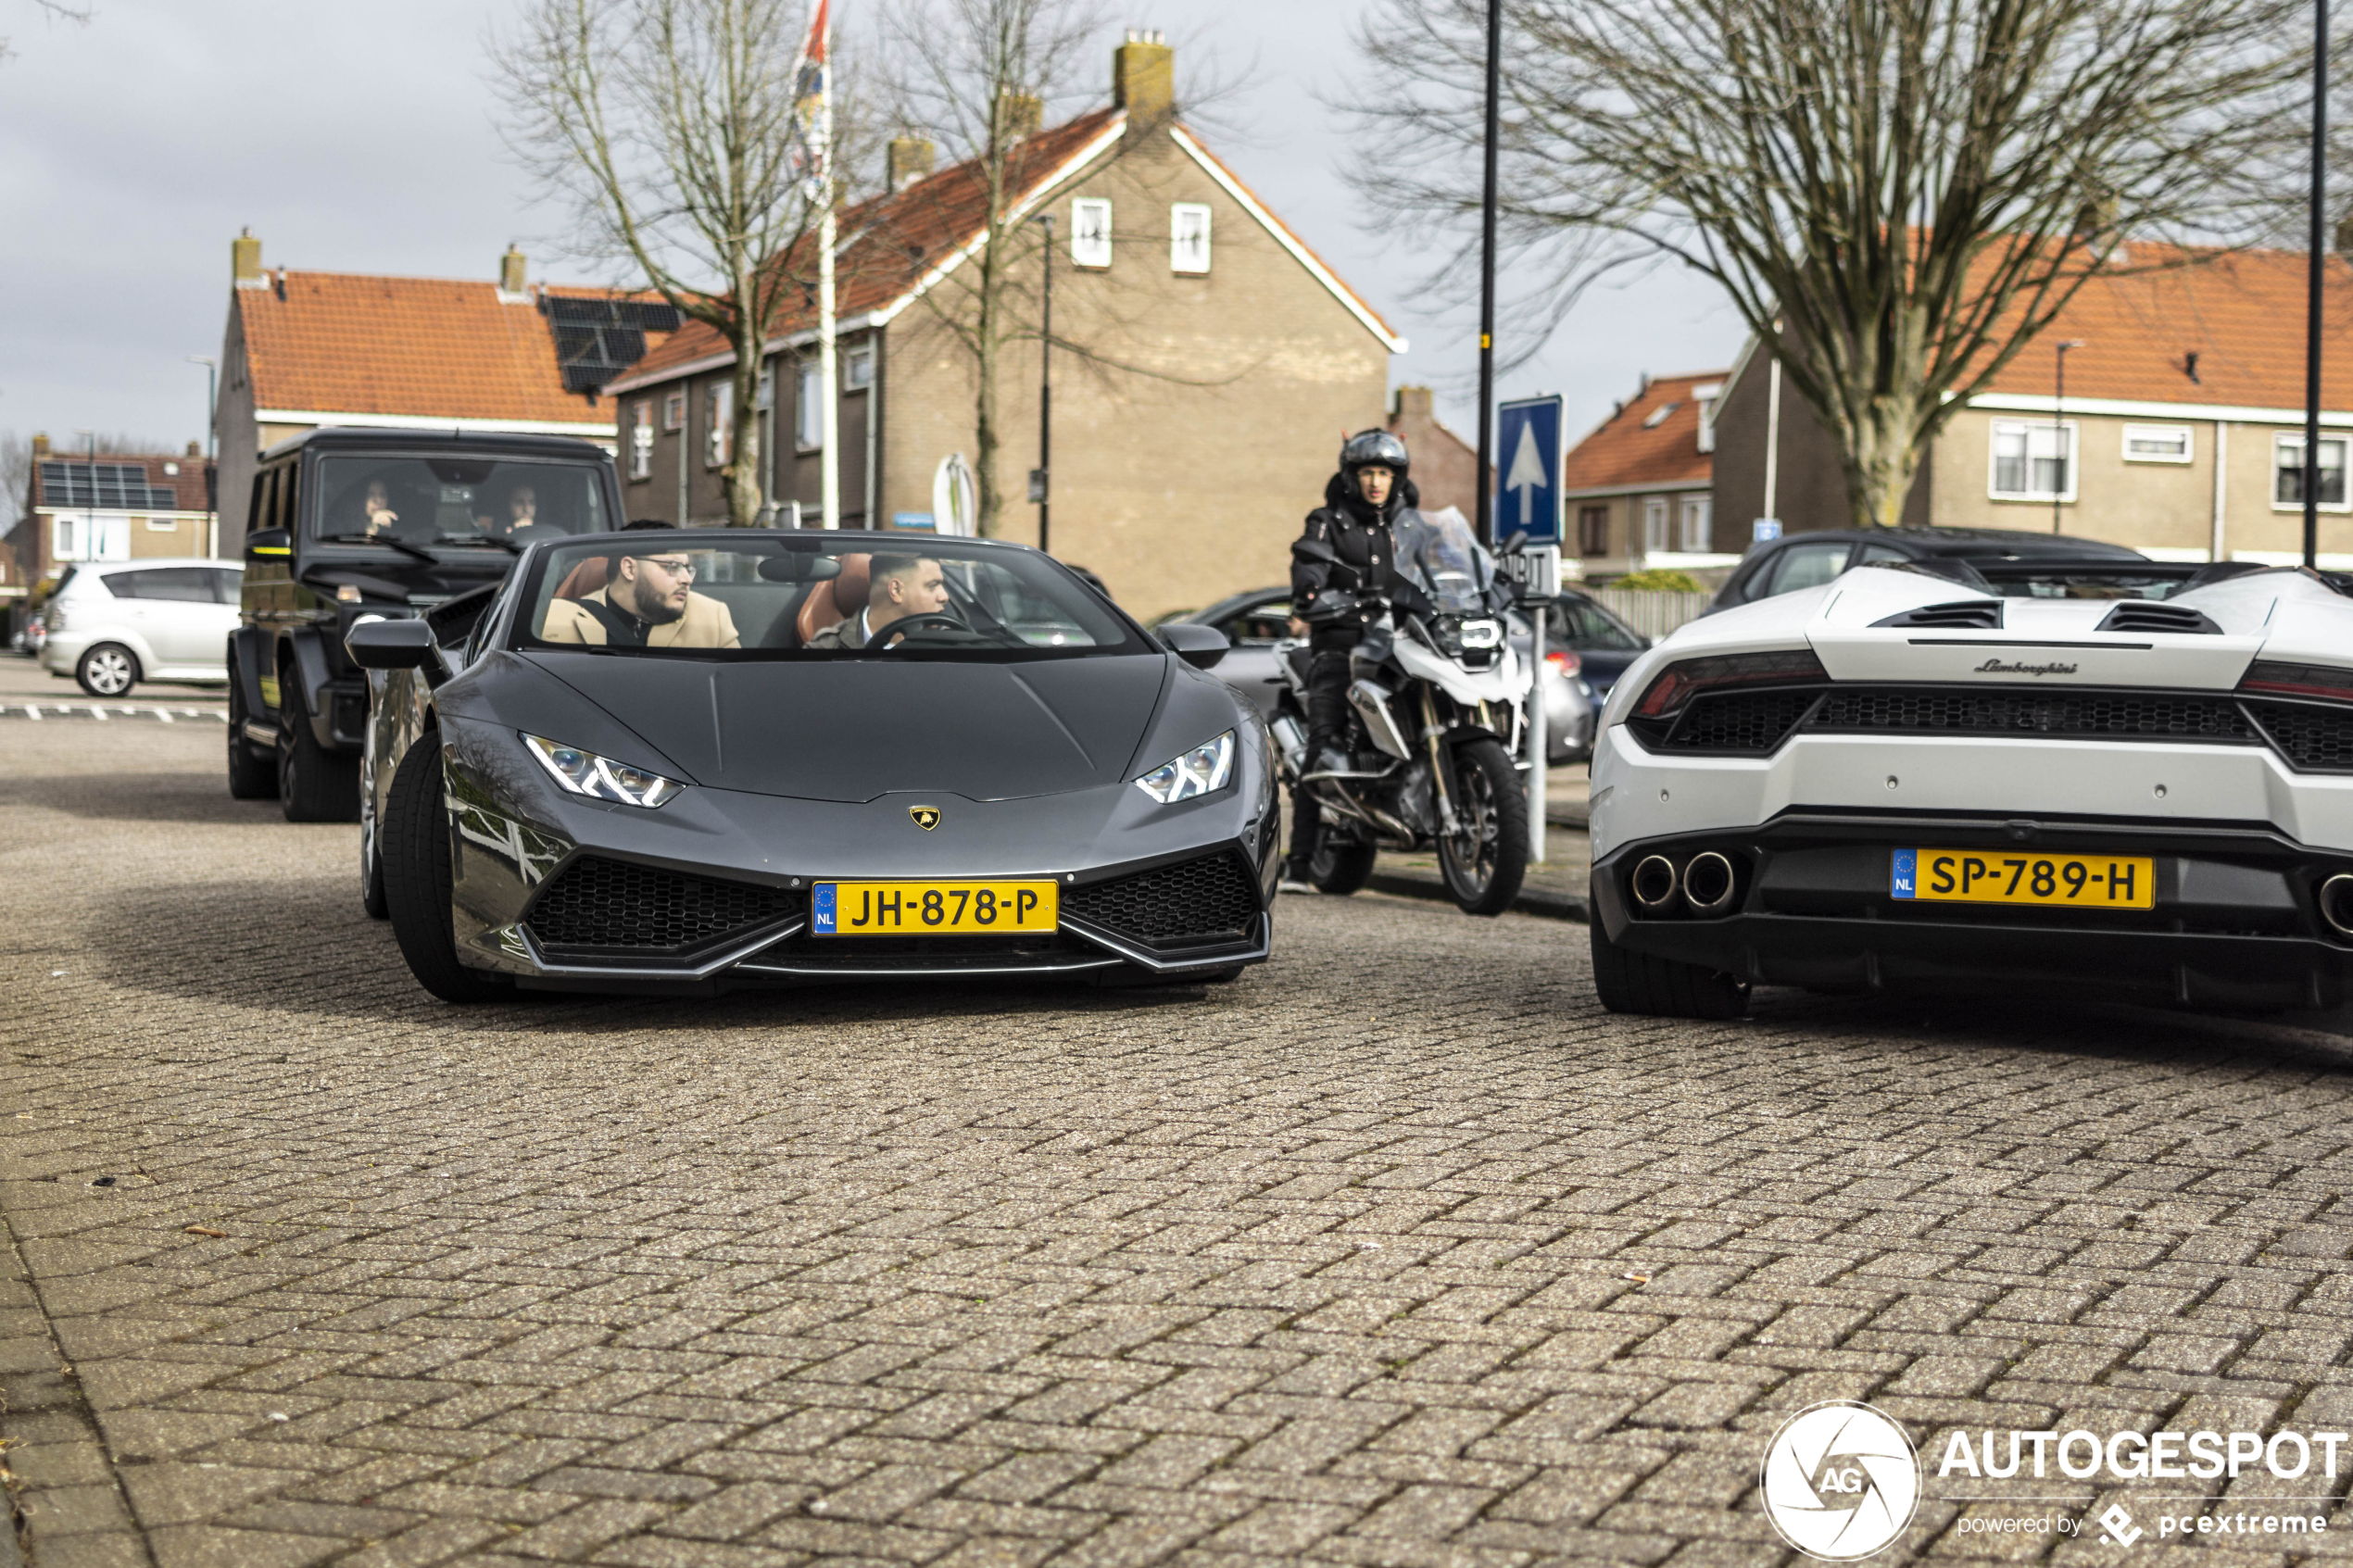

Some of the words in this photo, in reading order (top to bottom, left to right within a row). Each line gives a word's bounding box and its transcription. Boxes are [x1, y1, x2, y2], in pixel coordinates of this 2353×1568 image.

[1974, 659, 2078, 676] Lamborghini
[1895, 878, 1913, 891] NL
[1931, 857, 2135, 901] SP-789-H
[817, 913, 834, 925] NL
[851, 889, 1038, 927] JH-878-P
